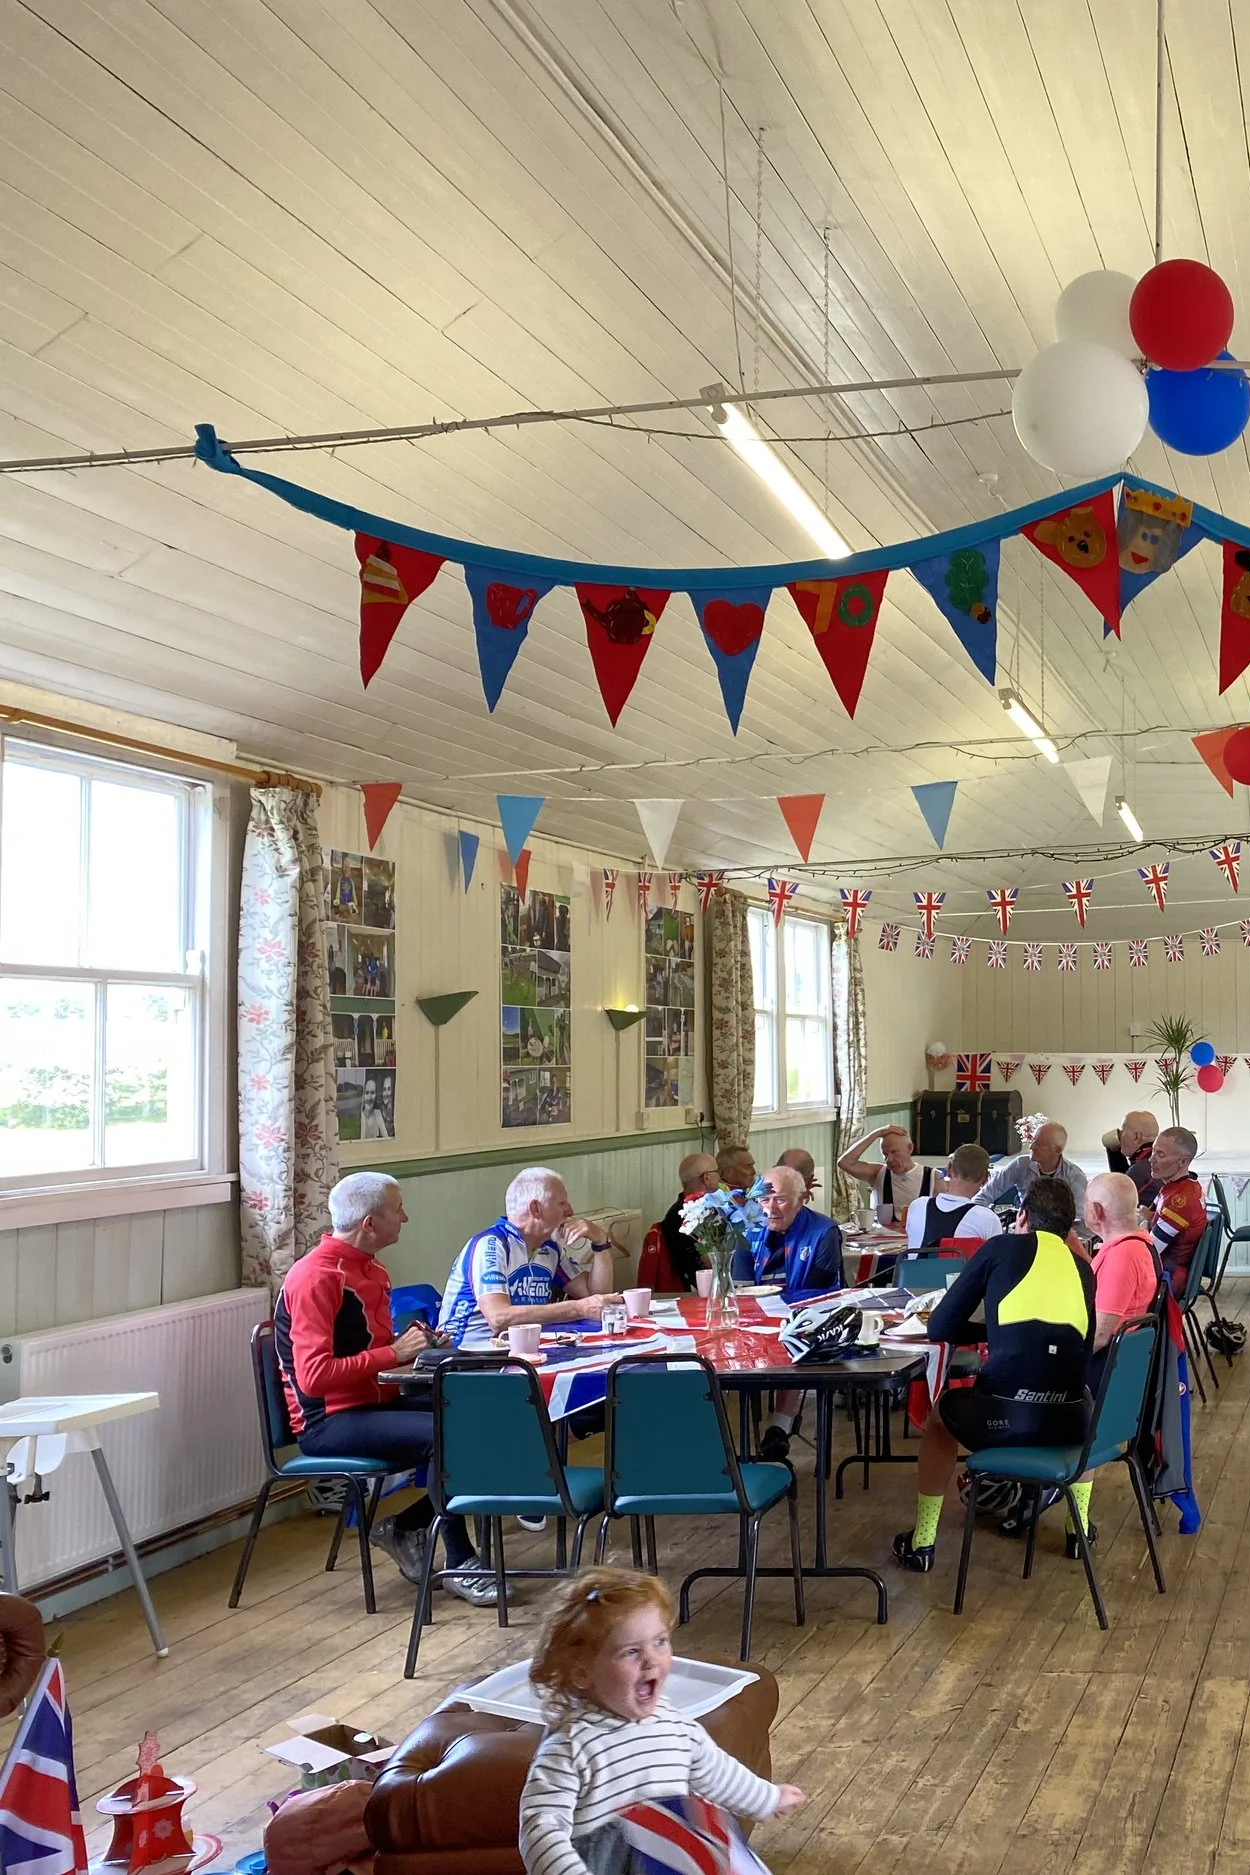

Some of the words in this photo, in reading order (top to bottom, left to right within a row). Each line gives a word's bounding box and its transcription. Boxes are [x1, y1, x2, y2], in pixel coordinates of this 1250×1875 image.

[796, 580, 873, 635] 70
[1014, 1389, 1067, 1403] Santini
[986, 1419, 1009, 1427] GORE
